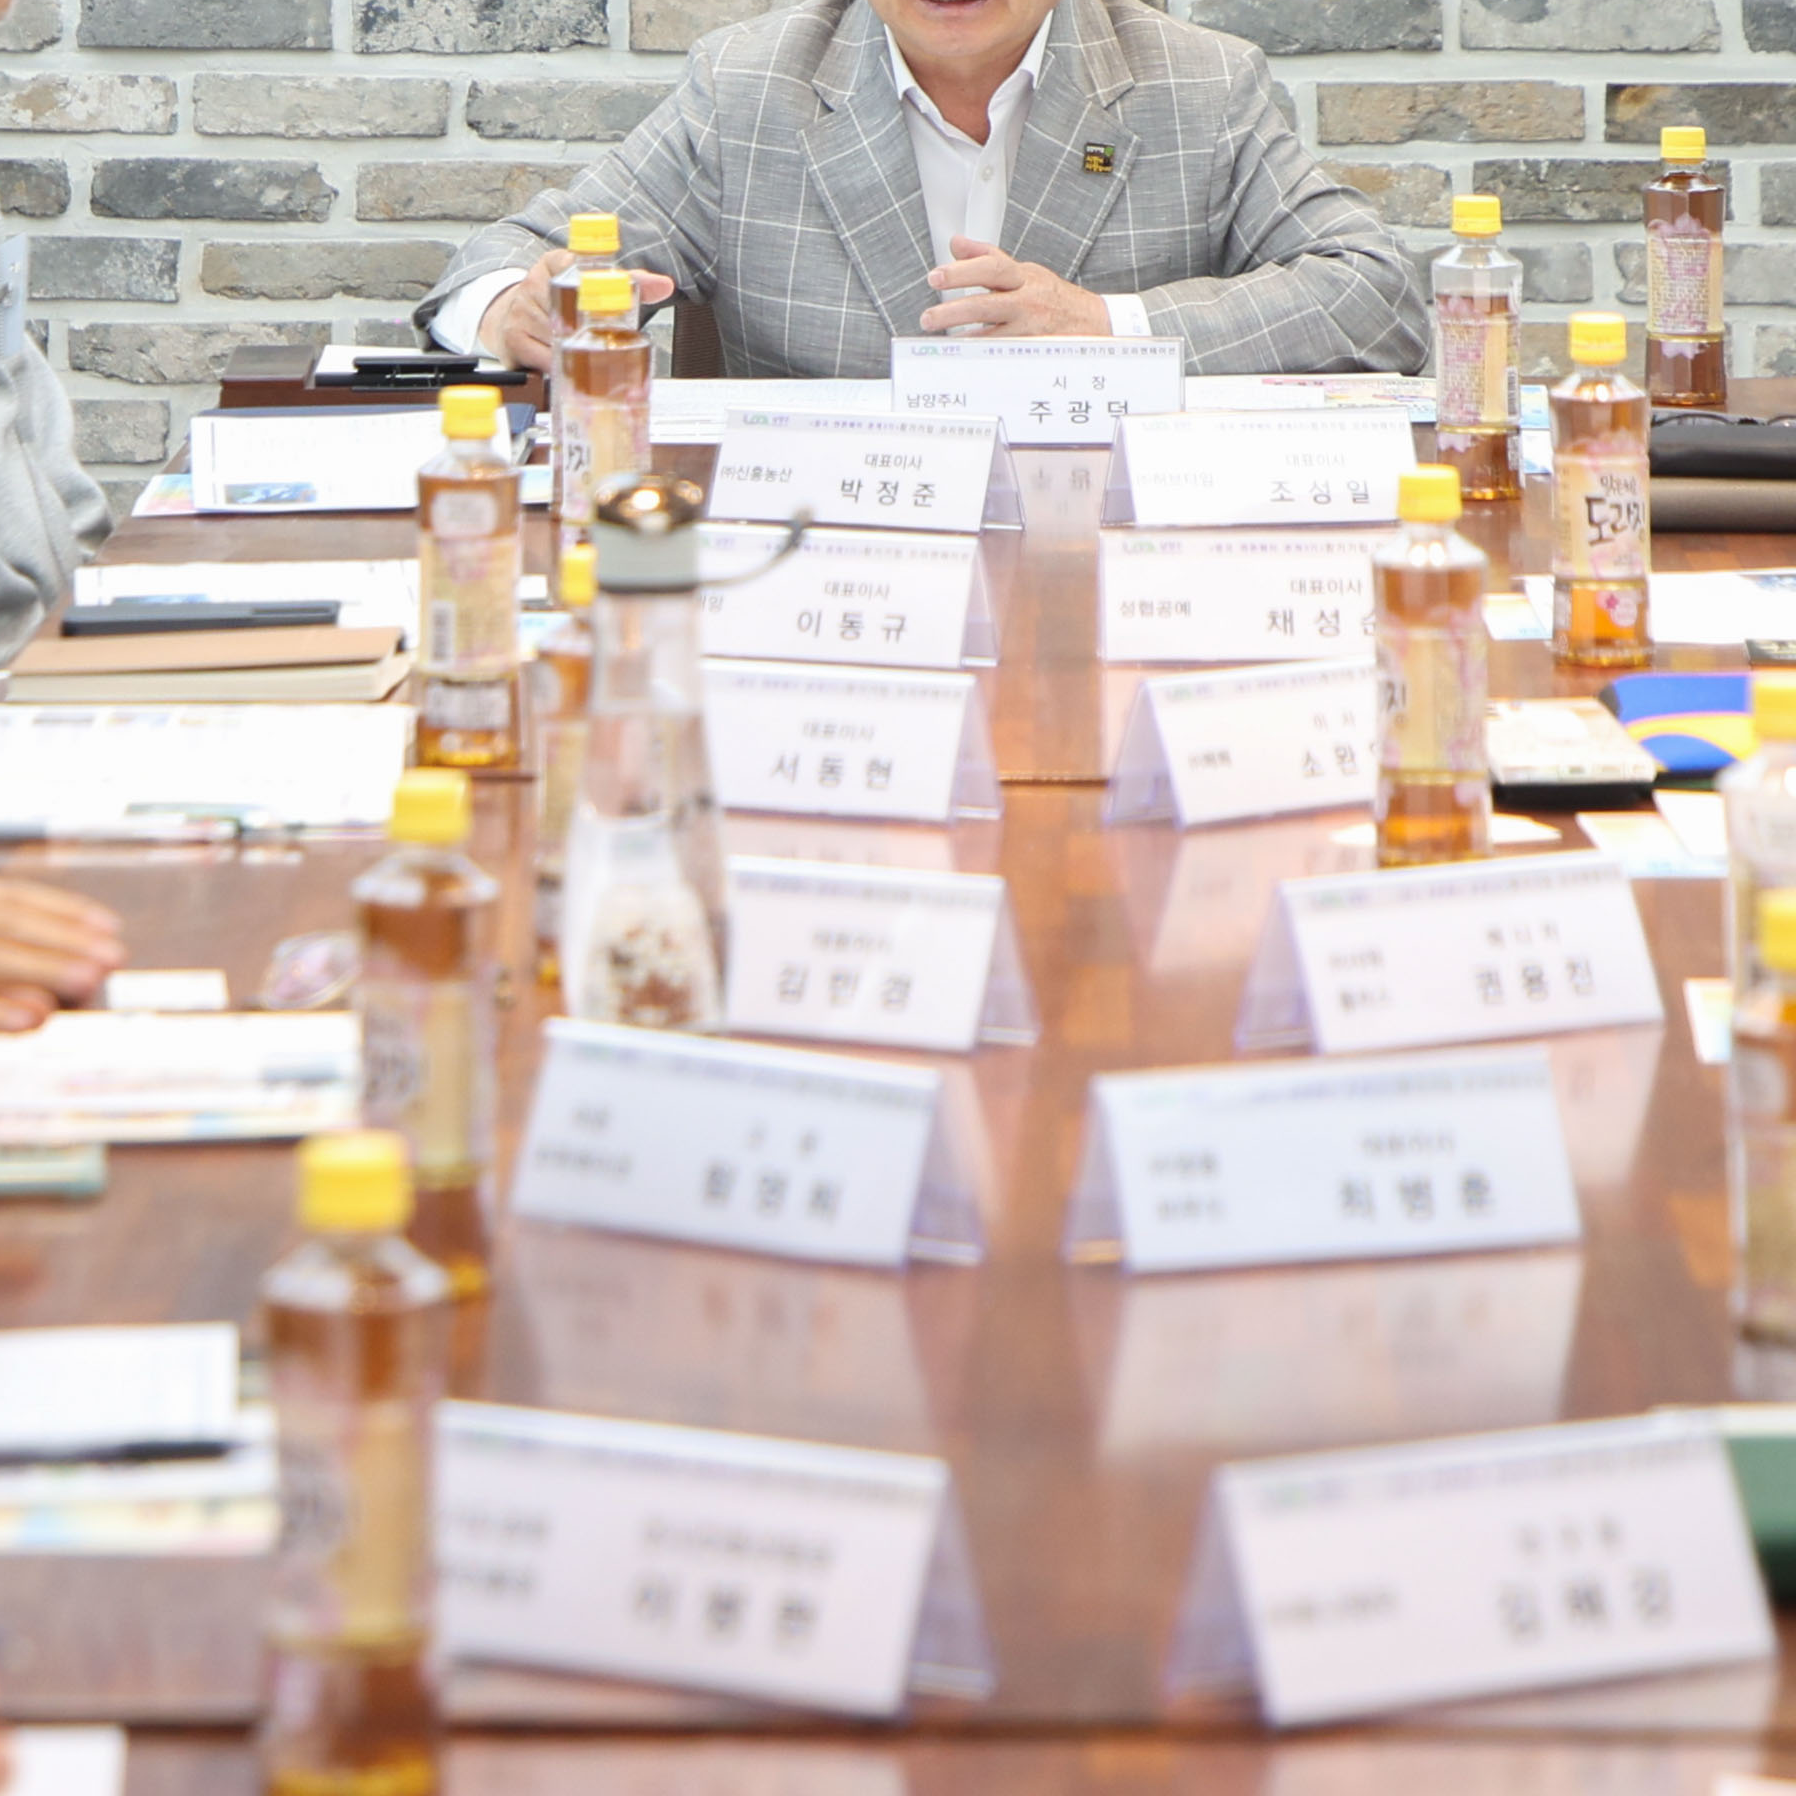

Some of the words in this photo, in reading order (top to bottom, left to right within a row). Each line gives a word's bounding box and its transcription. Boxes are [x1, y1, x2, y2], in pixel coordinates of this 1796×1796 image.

[906, 394, 967, 409] 남양주시
[864, 453, 923, 470] 대표이사
[823, 580, 891, 601] 대표이사
[1290, 578, 1364, 595] 대표이사
